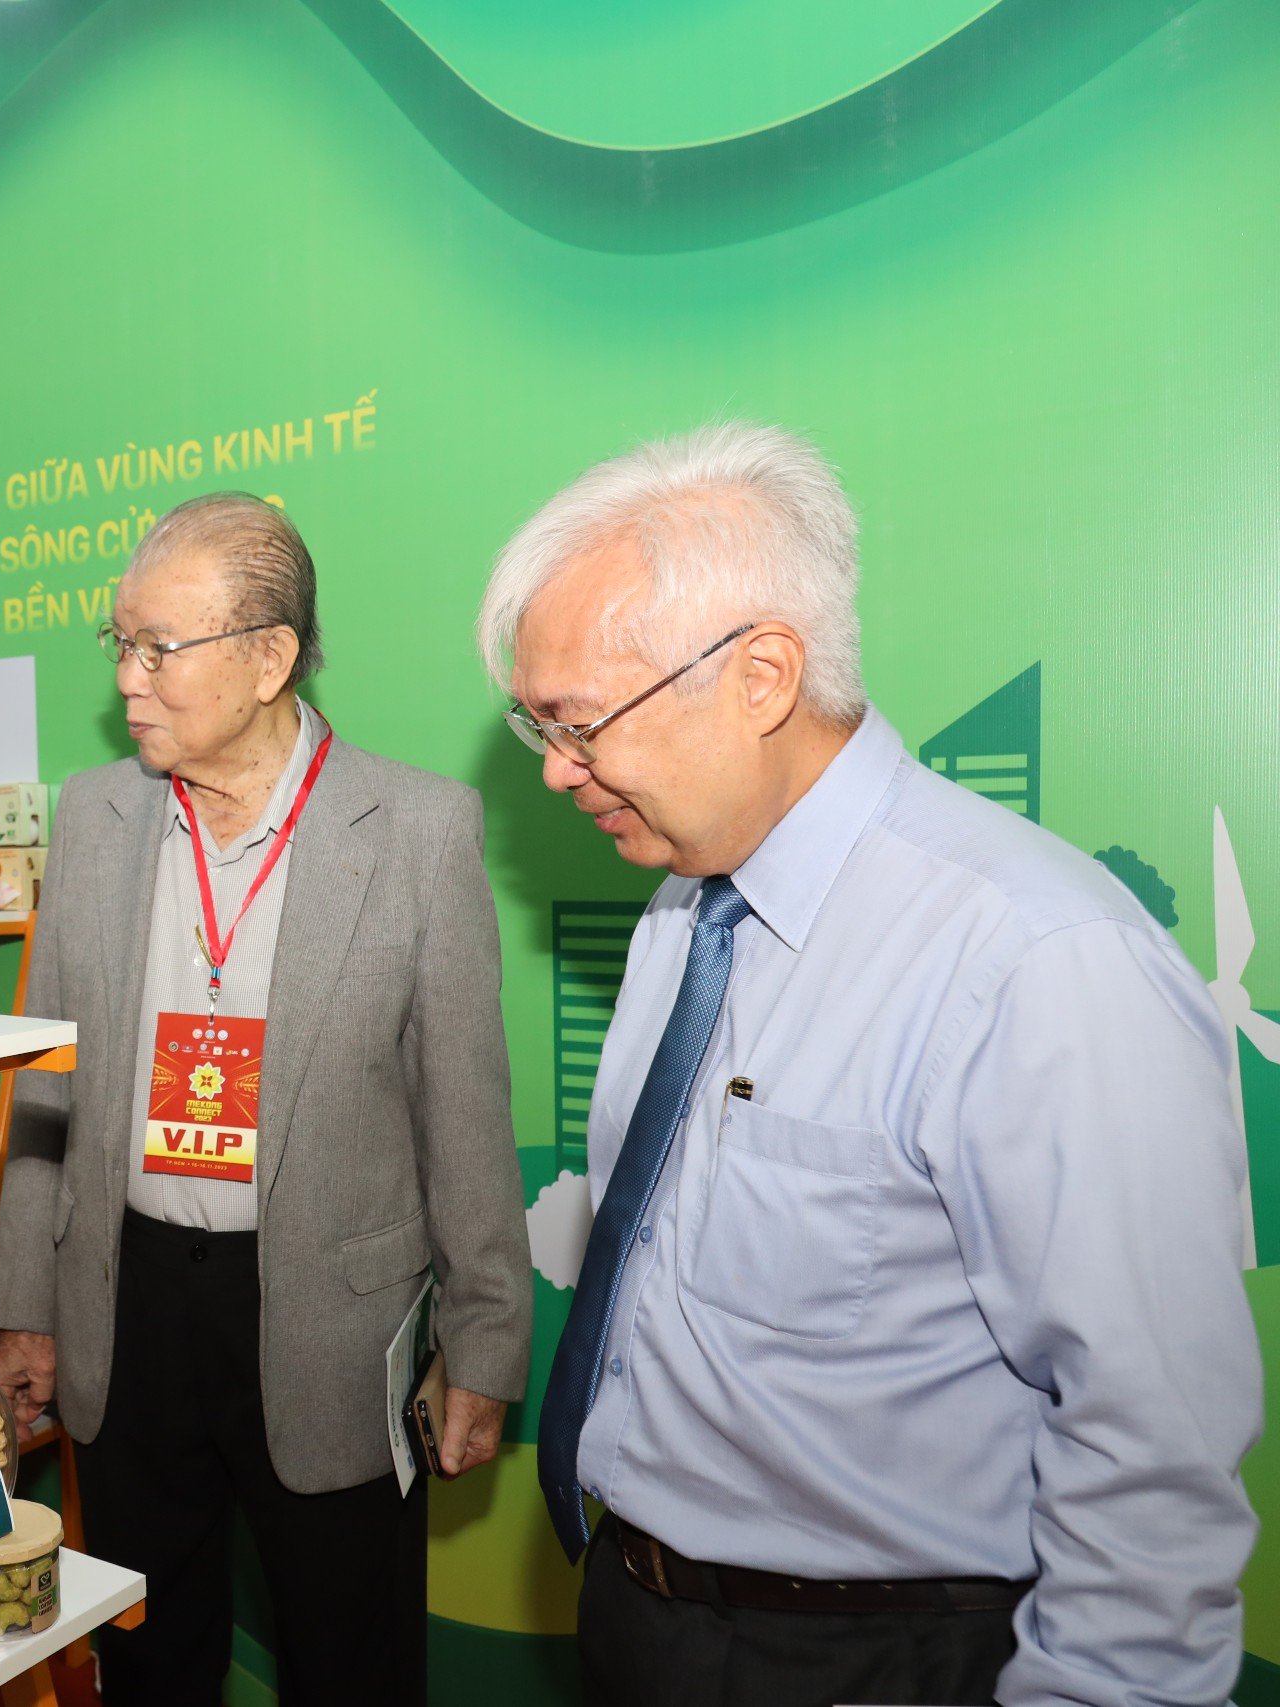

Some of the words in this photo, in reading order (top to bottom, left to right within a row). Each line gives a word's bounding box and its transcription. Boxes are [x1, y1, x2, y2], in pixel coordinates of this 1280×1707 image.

[6, 458, 88, 505] GIỮA
[95, 442, 203, 491] VÙNG
[214, 417, 314, 474] KINH
[324, 387, 379, 455] TẾ
[0, 523, 89, 573] SÔNG
[97, 505, 157, 560] CỬ
[4, 581, 70, 634] BỀN
[163, 1128, 243, 1156] V.I.P
